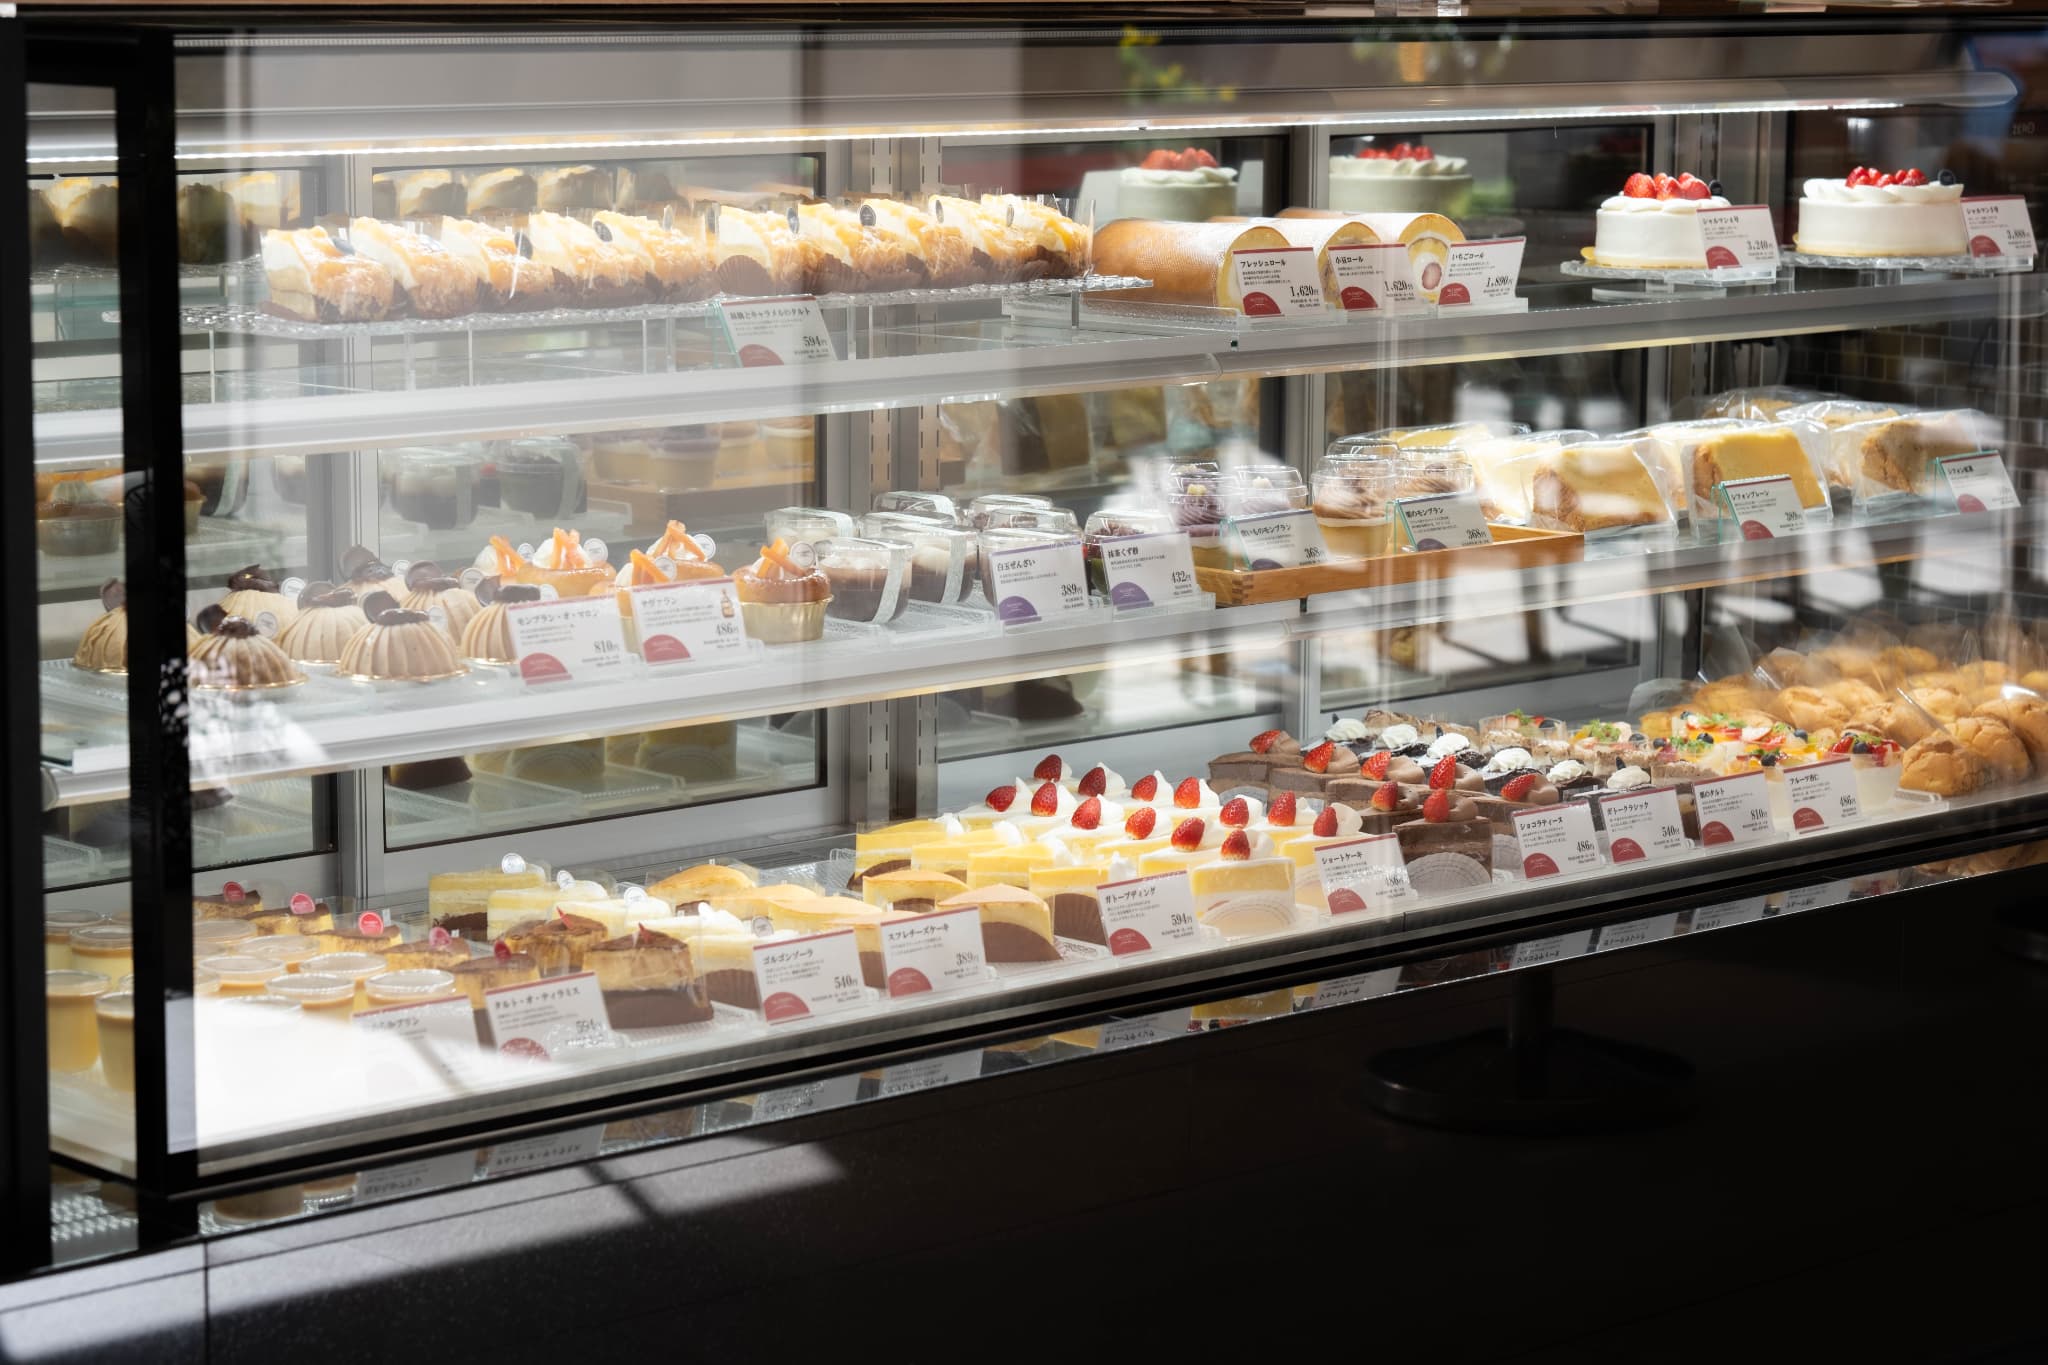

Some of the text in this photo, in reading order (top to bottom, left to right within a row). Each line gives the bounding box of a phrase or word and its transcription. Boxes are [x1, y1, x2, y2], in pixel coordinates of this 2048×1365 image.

[1240, 259, 1287, 268] フレッシュロール
[997, 558, 1037, 572] 白玉ぜんざい
[1321, 851, 1363, 865] ショートケーキ
[888, 923, 950, 942] スフレチーズケーキ
[762, 948, 814, 965] ゴルゴンゾーラ
